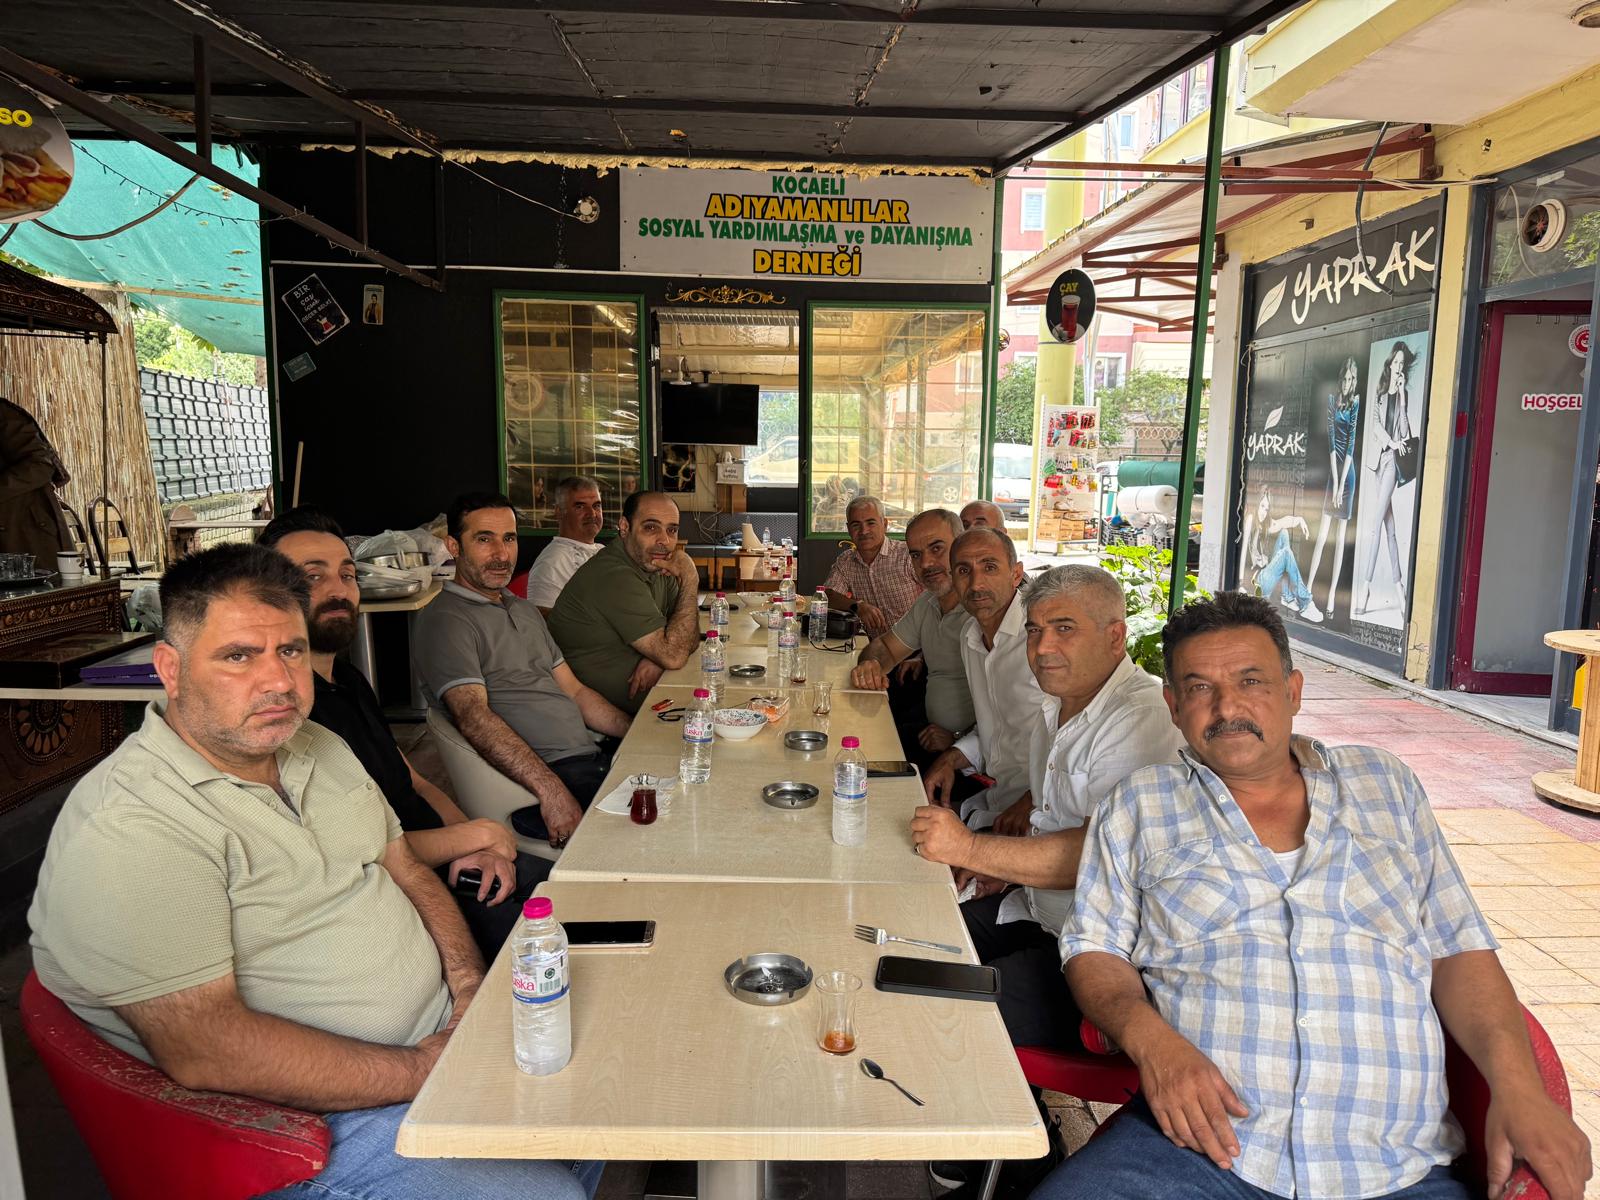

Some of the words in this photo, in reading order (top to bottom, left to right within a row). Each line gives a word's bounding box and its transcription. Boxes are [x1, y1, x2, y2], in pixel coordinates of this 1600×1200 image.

[704, 194, 910, 224] ADIYAMANLILAR
[638, 217, 705, 238] SOSYAL
[711, 221, 837, 248] YARDIMLAŞMA
[844, 230, 865, 244] ve
[870, 230, 973, 251] DAYANIŞMA
[753, 245, 863, 276] DERNEĞİ
[1291, 226, 1436, 325] YAPRAK
[1060, 282, 1079, 296] ÇAY
[1247, 432, 1306, 461] YAPRAK
